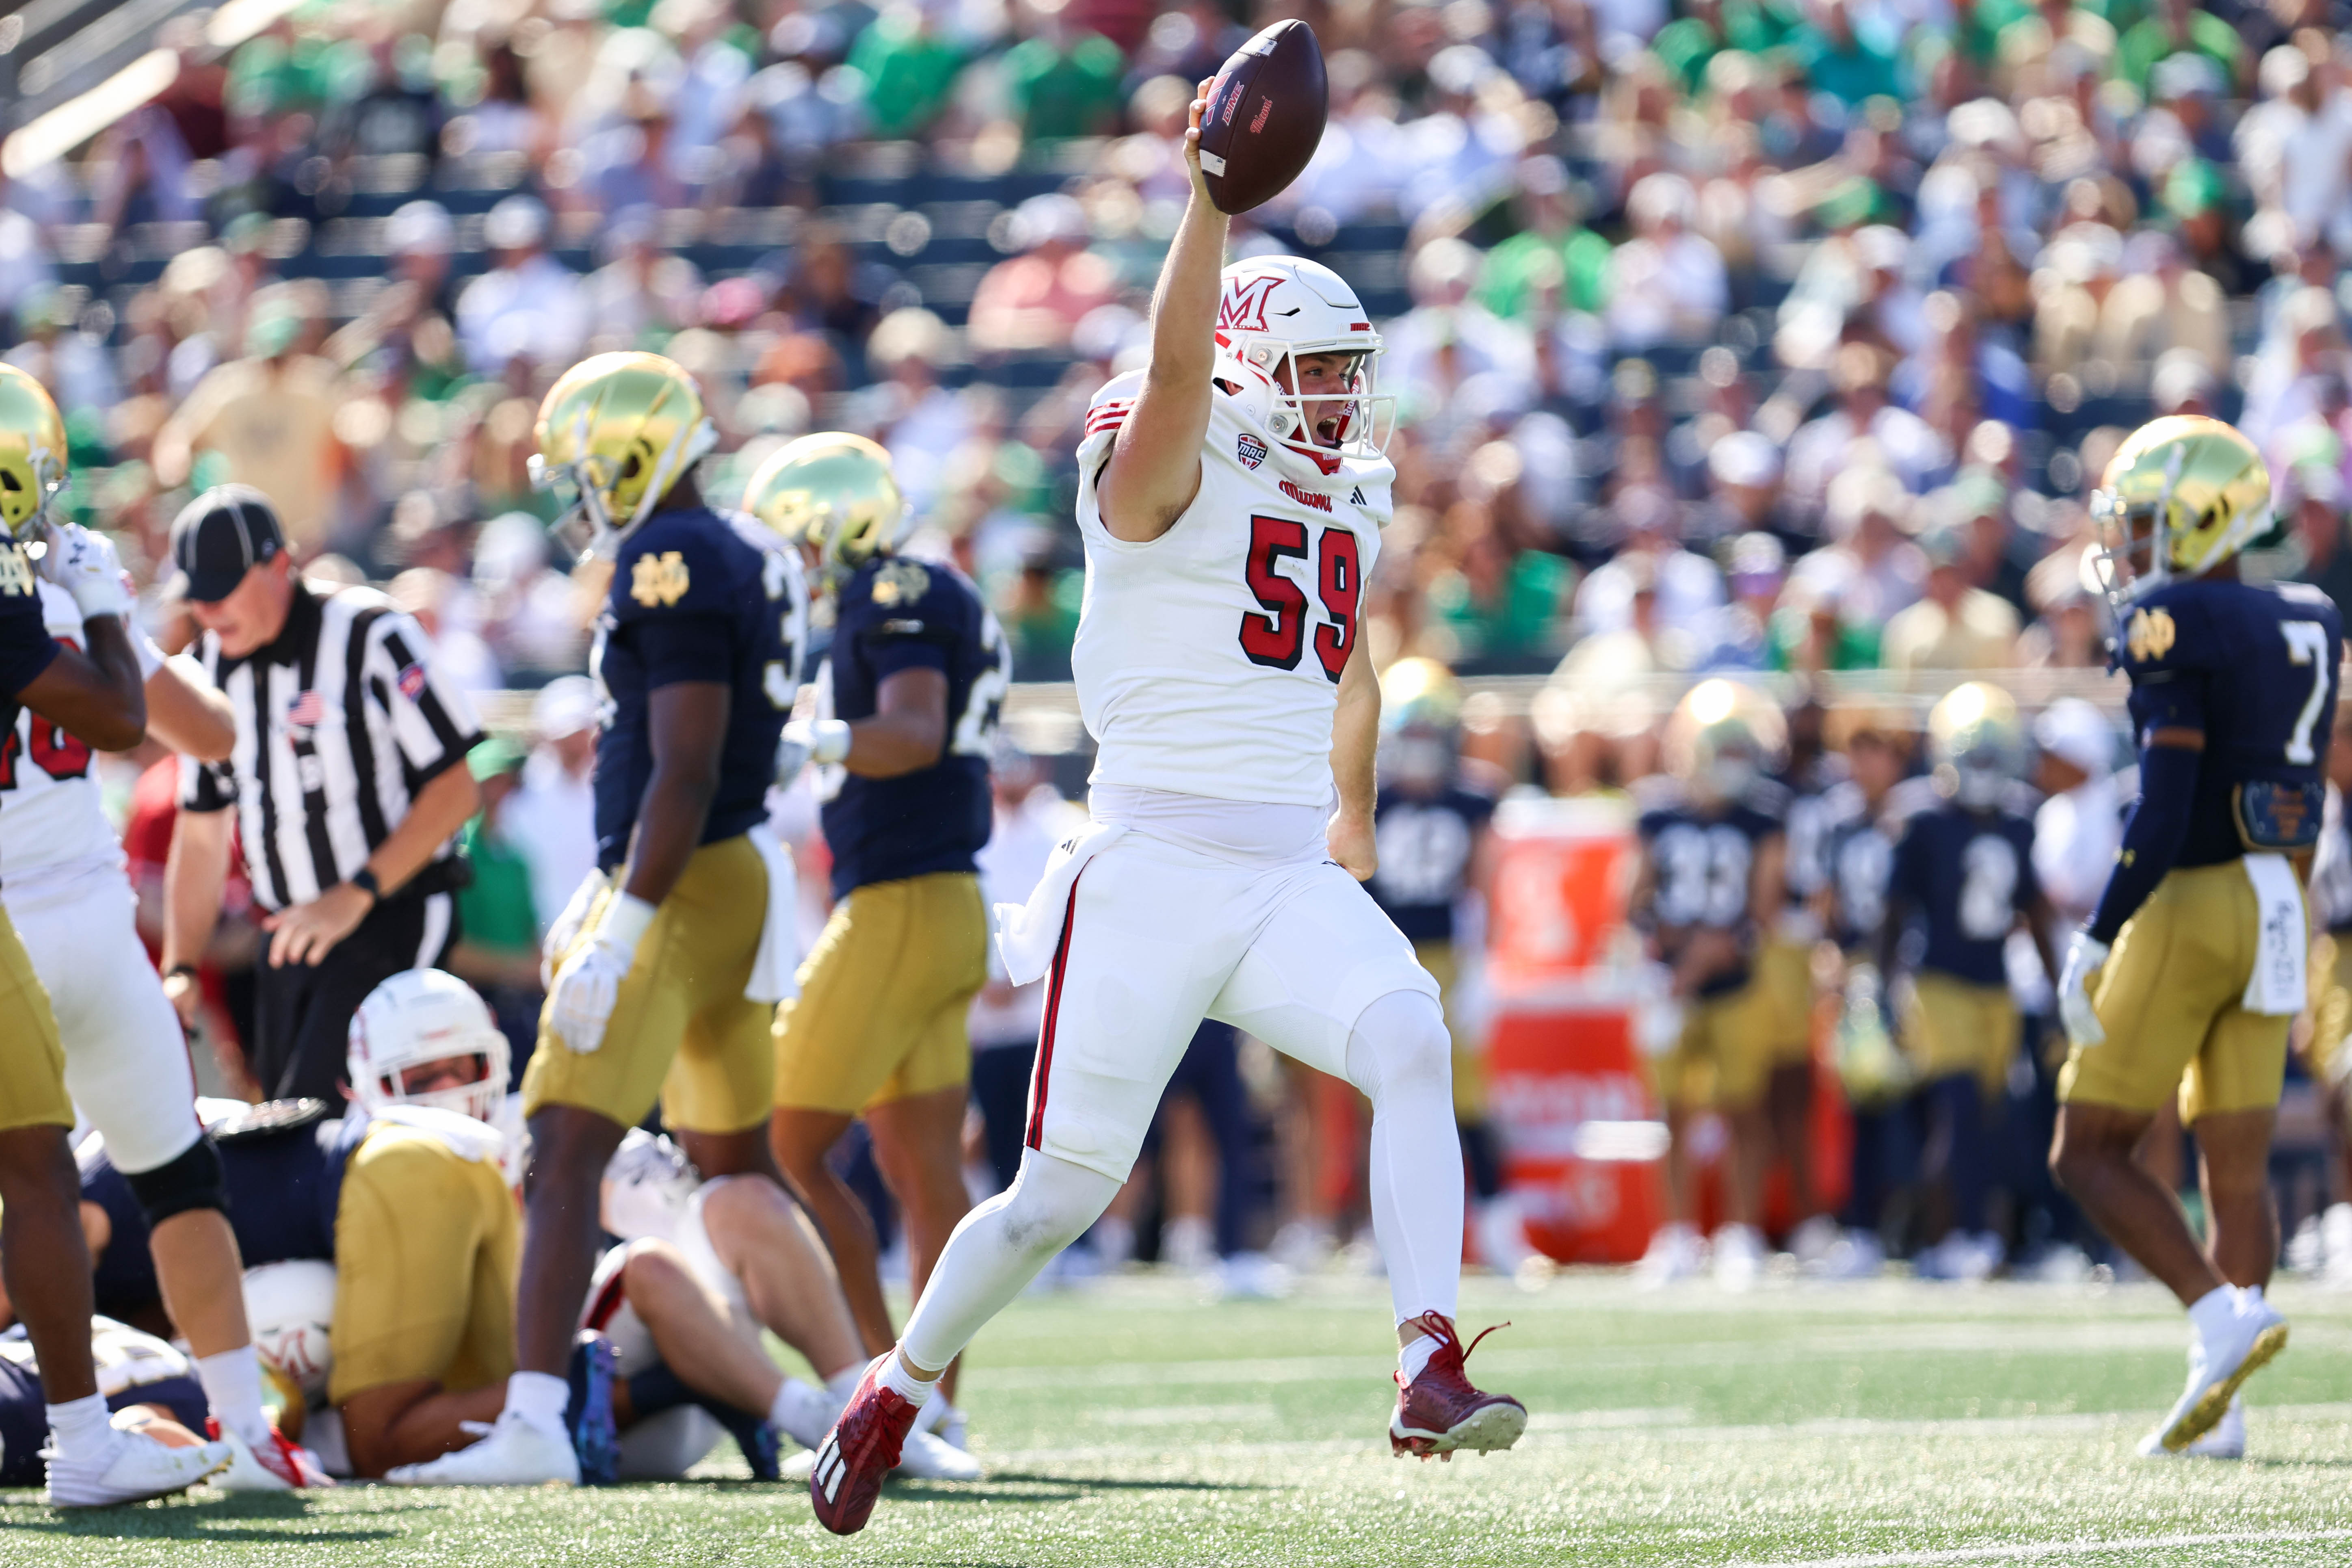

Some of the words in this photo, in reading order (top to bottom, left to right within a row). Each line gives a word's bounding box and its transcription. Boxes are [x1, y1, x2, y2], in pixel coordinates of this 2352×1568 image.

[1222, 80, 1244, 126] DIME
[1250, 95, 1273, 134] Miami
[1216, 276, 1287, 332] M
[1238, 443, 1266, 460] MAC
[1238, 514, 1361, 684] 59
[2278, 620, 2329, 764] 7
